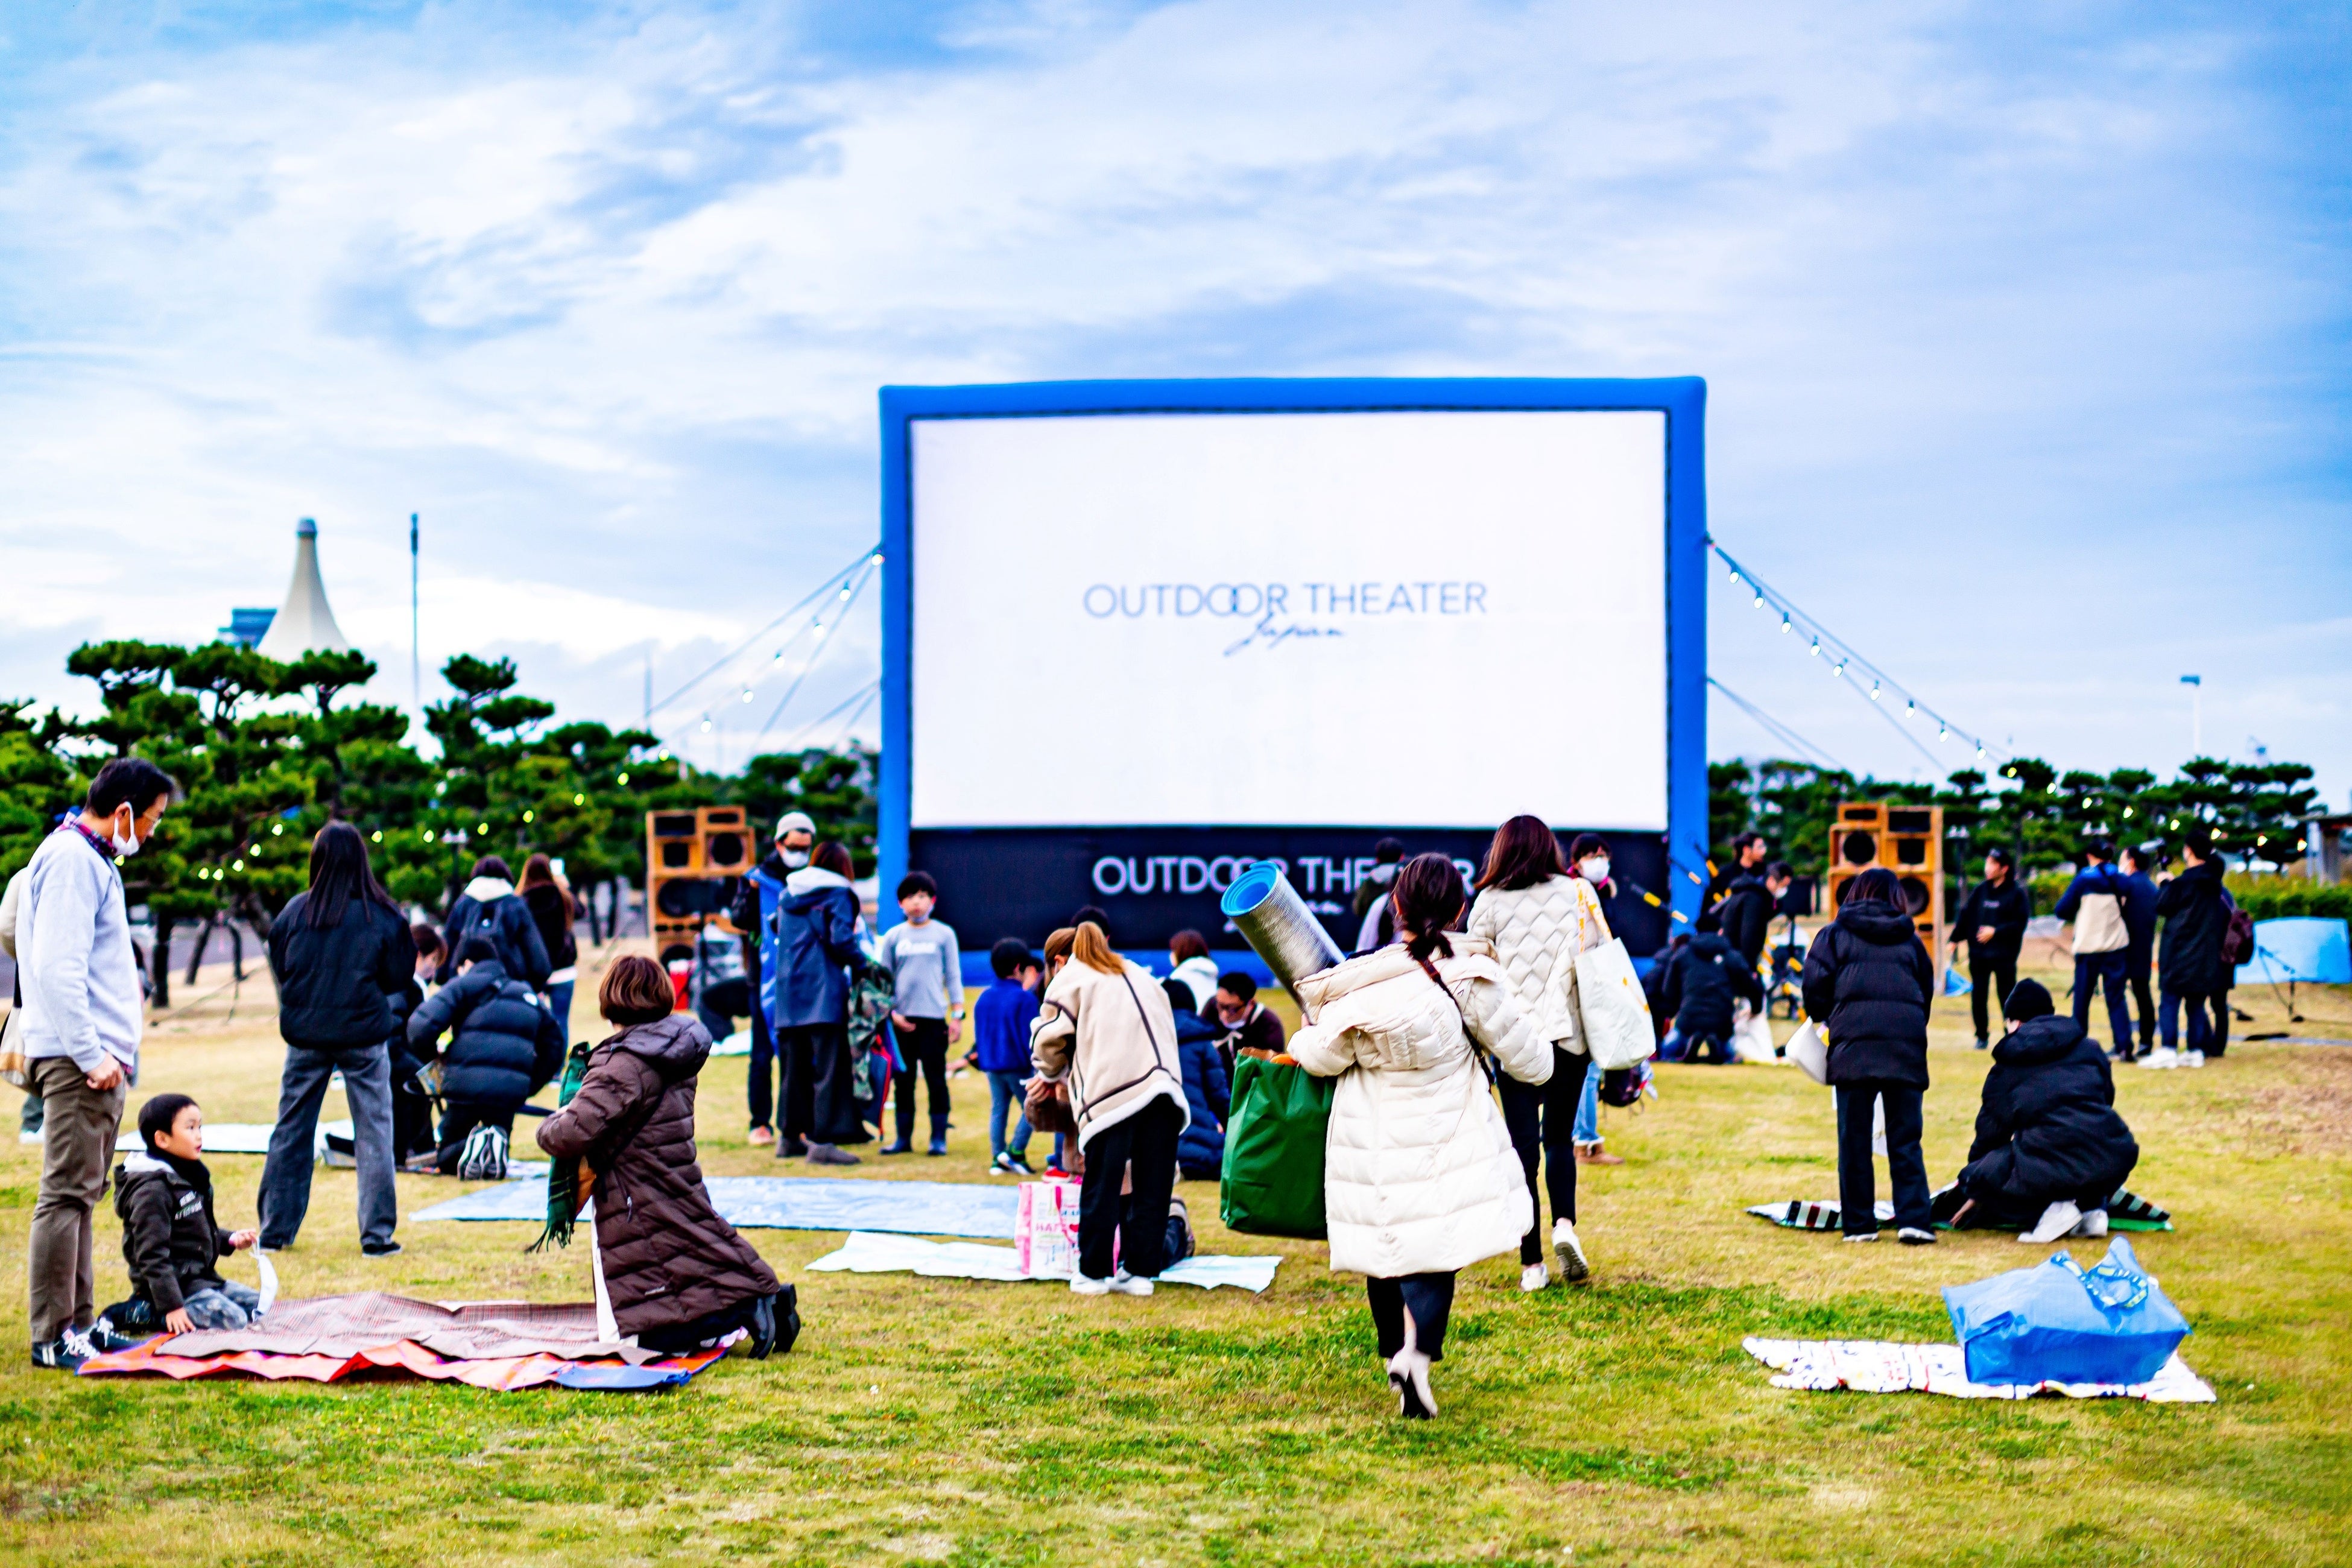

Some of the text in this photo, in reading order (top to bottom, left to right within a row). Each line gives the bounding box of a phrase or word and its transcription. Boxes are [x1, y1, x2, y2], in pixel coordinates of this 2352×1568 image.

[1084, 581, 1488, 618] OUTDOOR THEATER
[1297, 857, 1477, 895] THER
